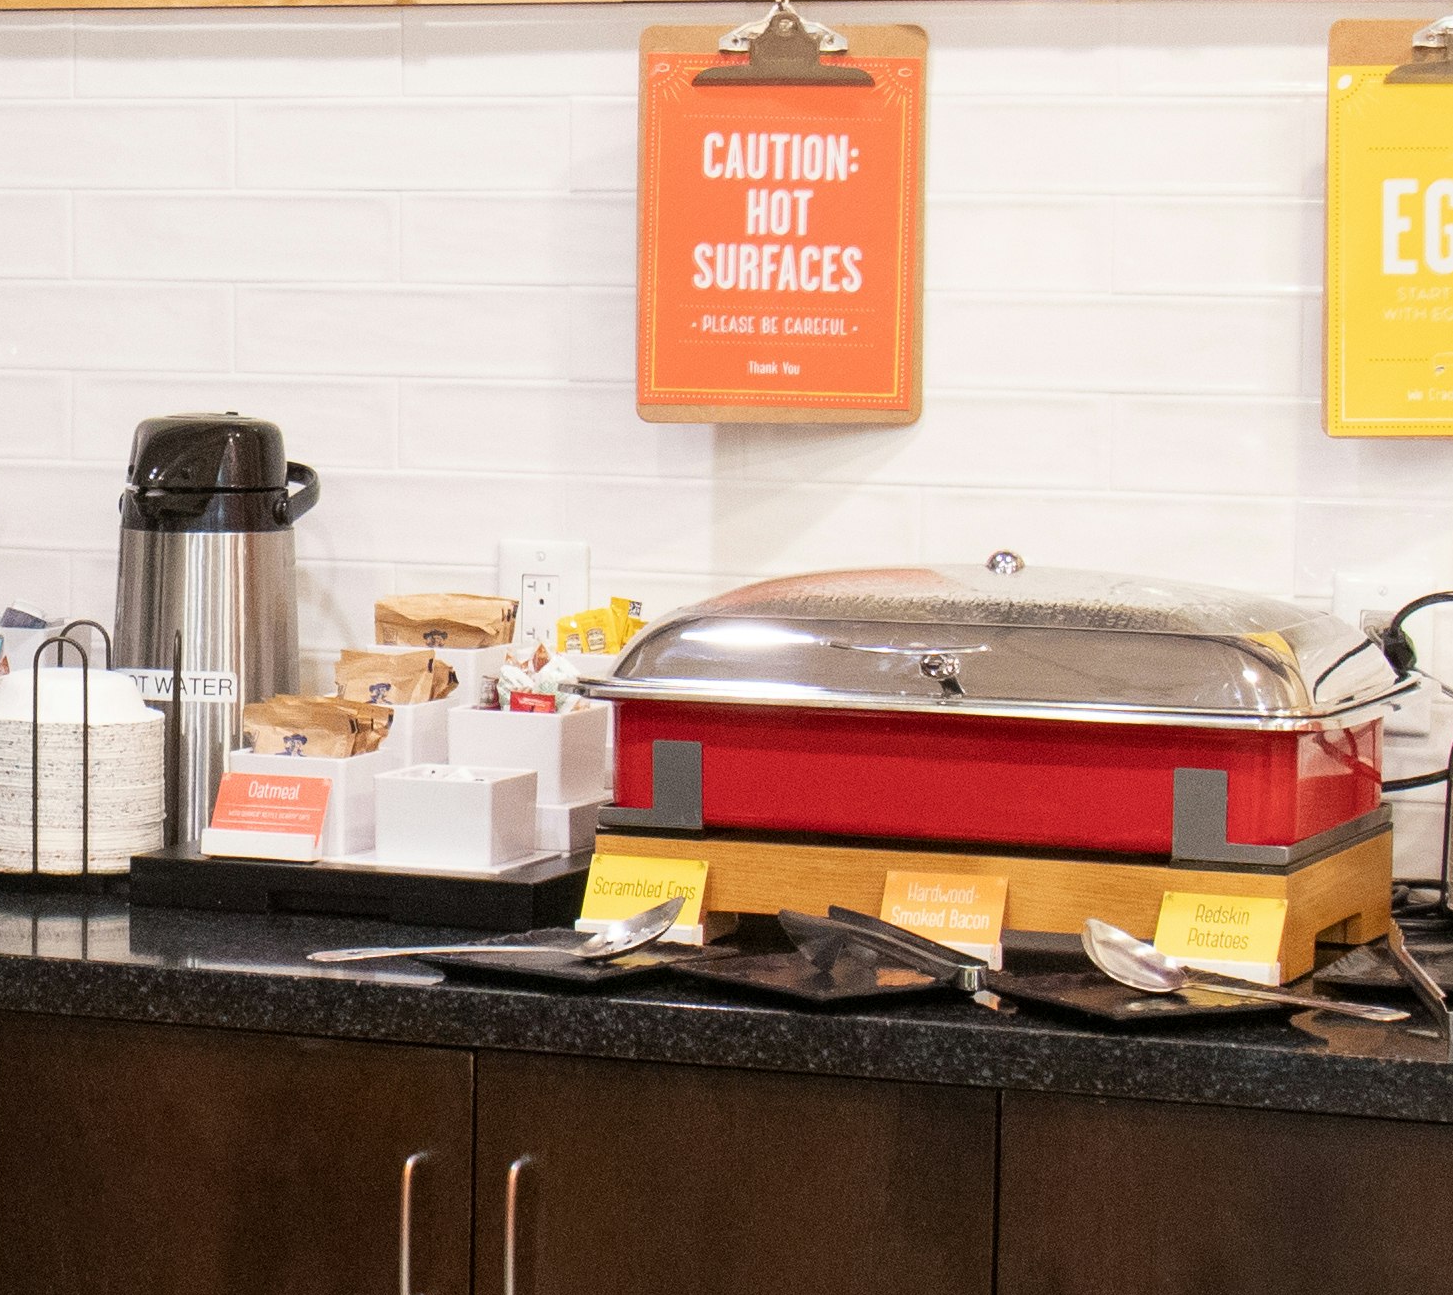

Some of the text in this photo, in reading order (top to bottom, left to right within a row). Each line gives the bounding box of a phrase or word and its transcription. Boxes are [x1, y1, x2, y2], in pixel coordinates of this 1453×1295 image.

[702, 132, 860, 180] CAUTION:
[746, 189, 814, 236] HOT
[692, 242, 863, 293] SURFACES
[1396, 286, 1453, 301] START
[1383, 306, 1428, 321] WITH
[702, 315, 848, 336] PLEASE BE CAREFUL
[748, 360, 801, 375] Thank You
[248, 780, 301, 801] Oatmeal
[593, 876, 663, 898] Scrambled
[907, 882, 980, 904] Hardwood-
[891, 906, 990, 930] Smoked Bacon
[1195, 903, 1250, 925] Redskin
[1186, 927, 1250, 950] Potatoes
